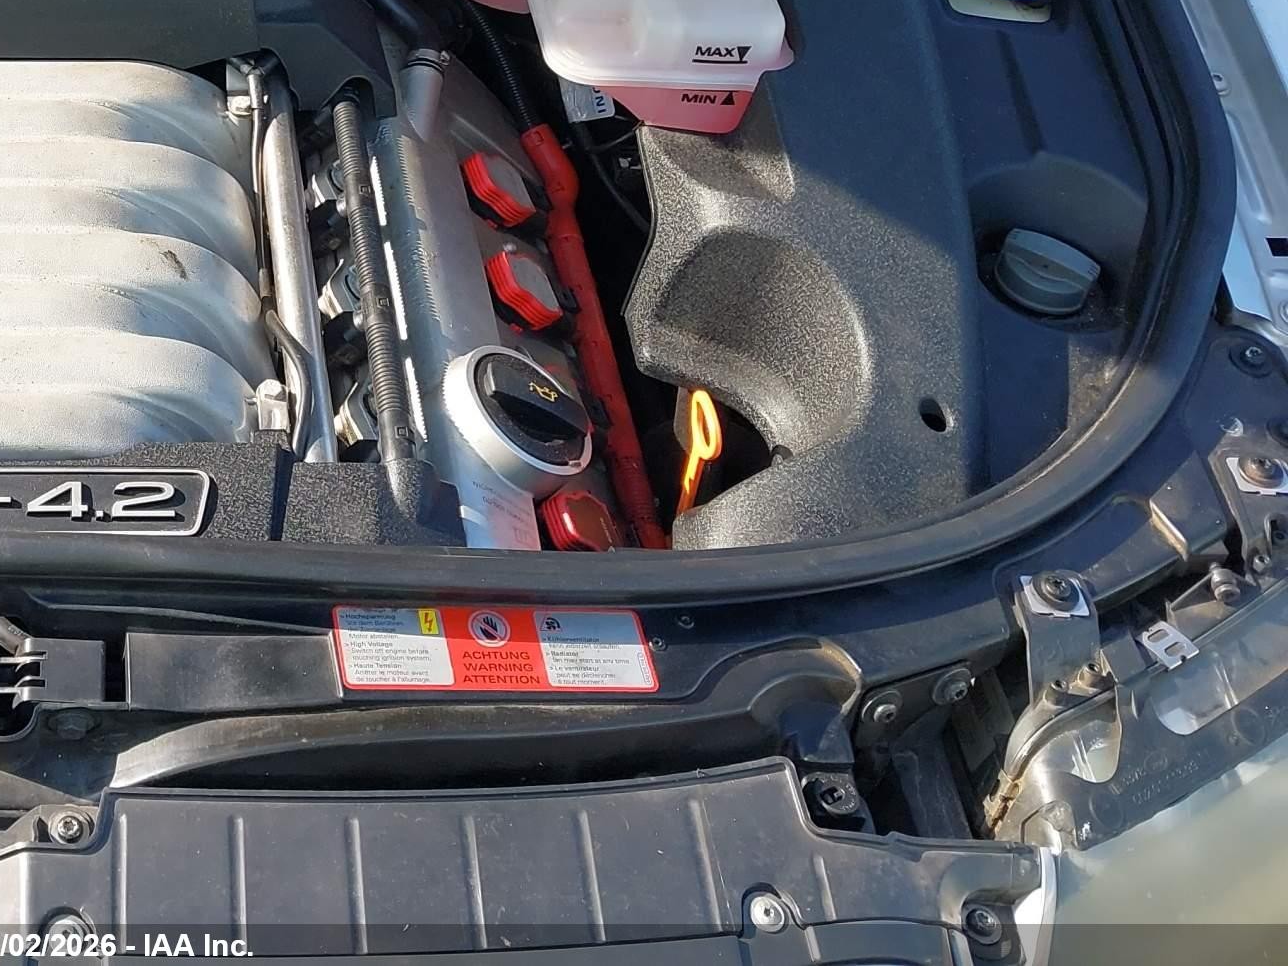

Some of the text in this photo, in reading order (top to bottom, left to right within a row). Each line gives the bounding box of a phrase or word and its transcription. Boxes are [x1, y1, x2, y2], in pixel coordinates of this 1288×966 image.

[695, 46, 736, 57] MAX
[681, 93, 717, 104] MIN
[462, 651, 530, 660] ACHTUNG
[463, 663, 534, 672] WARNING
[463, 675, 540, 684] ATTENTION
